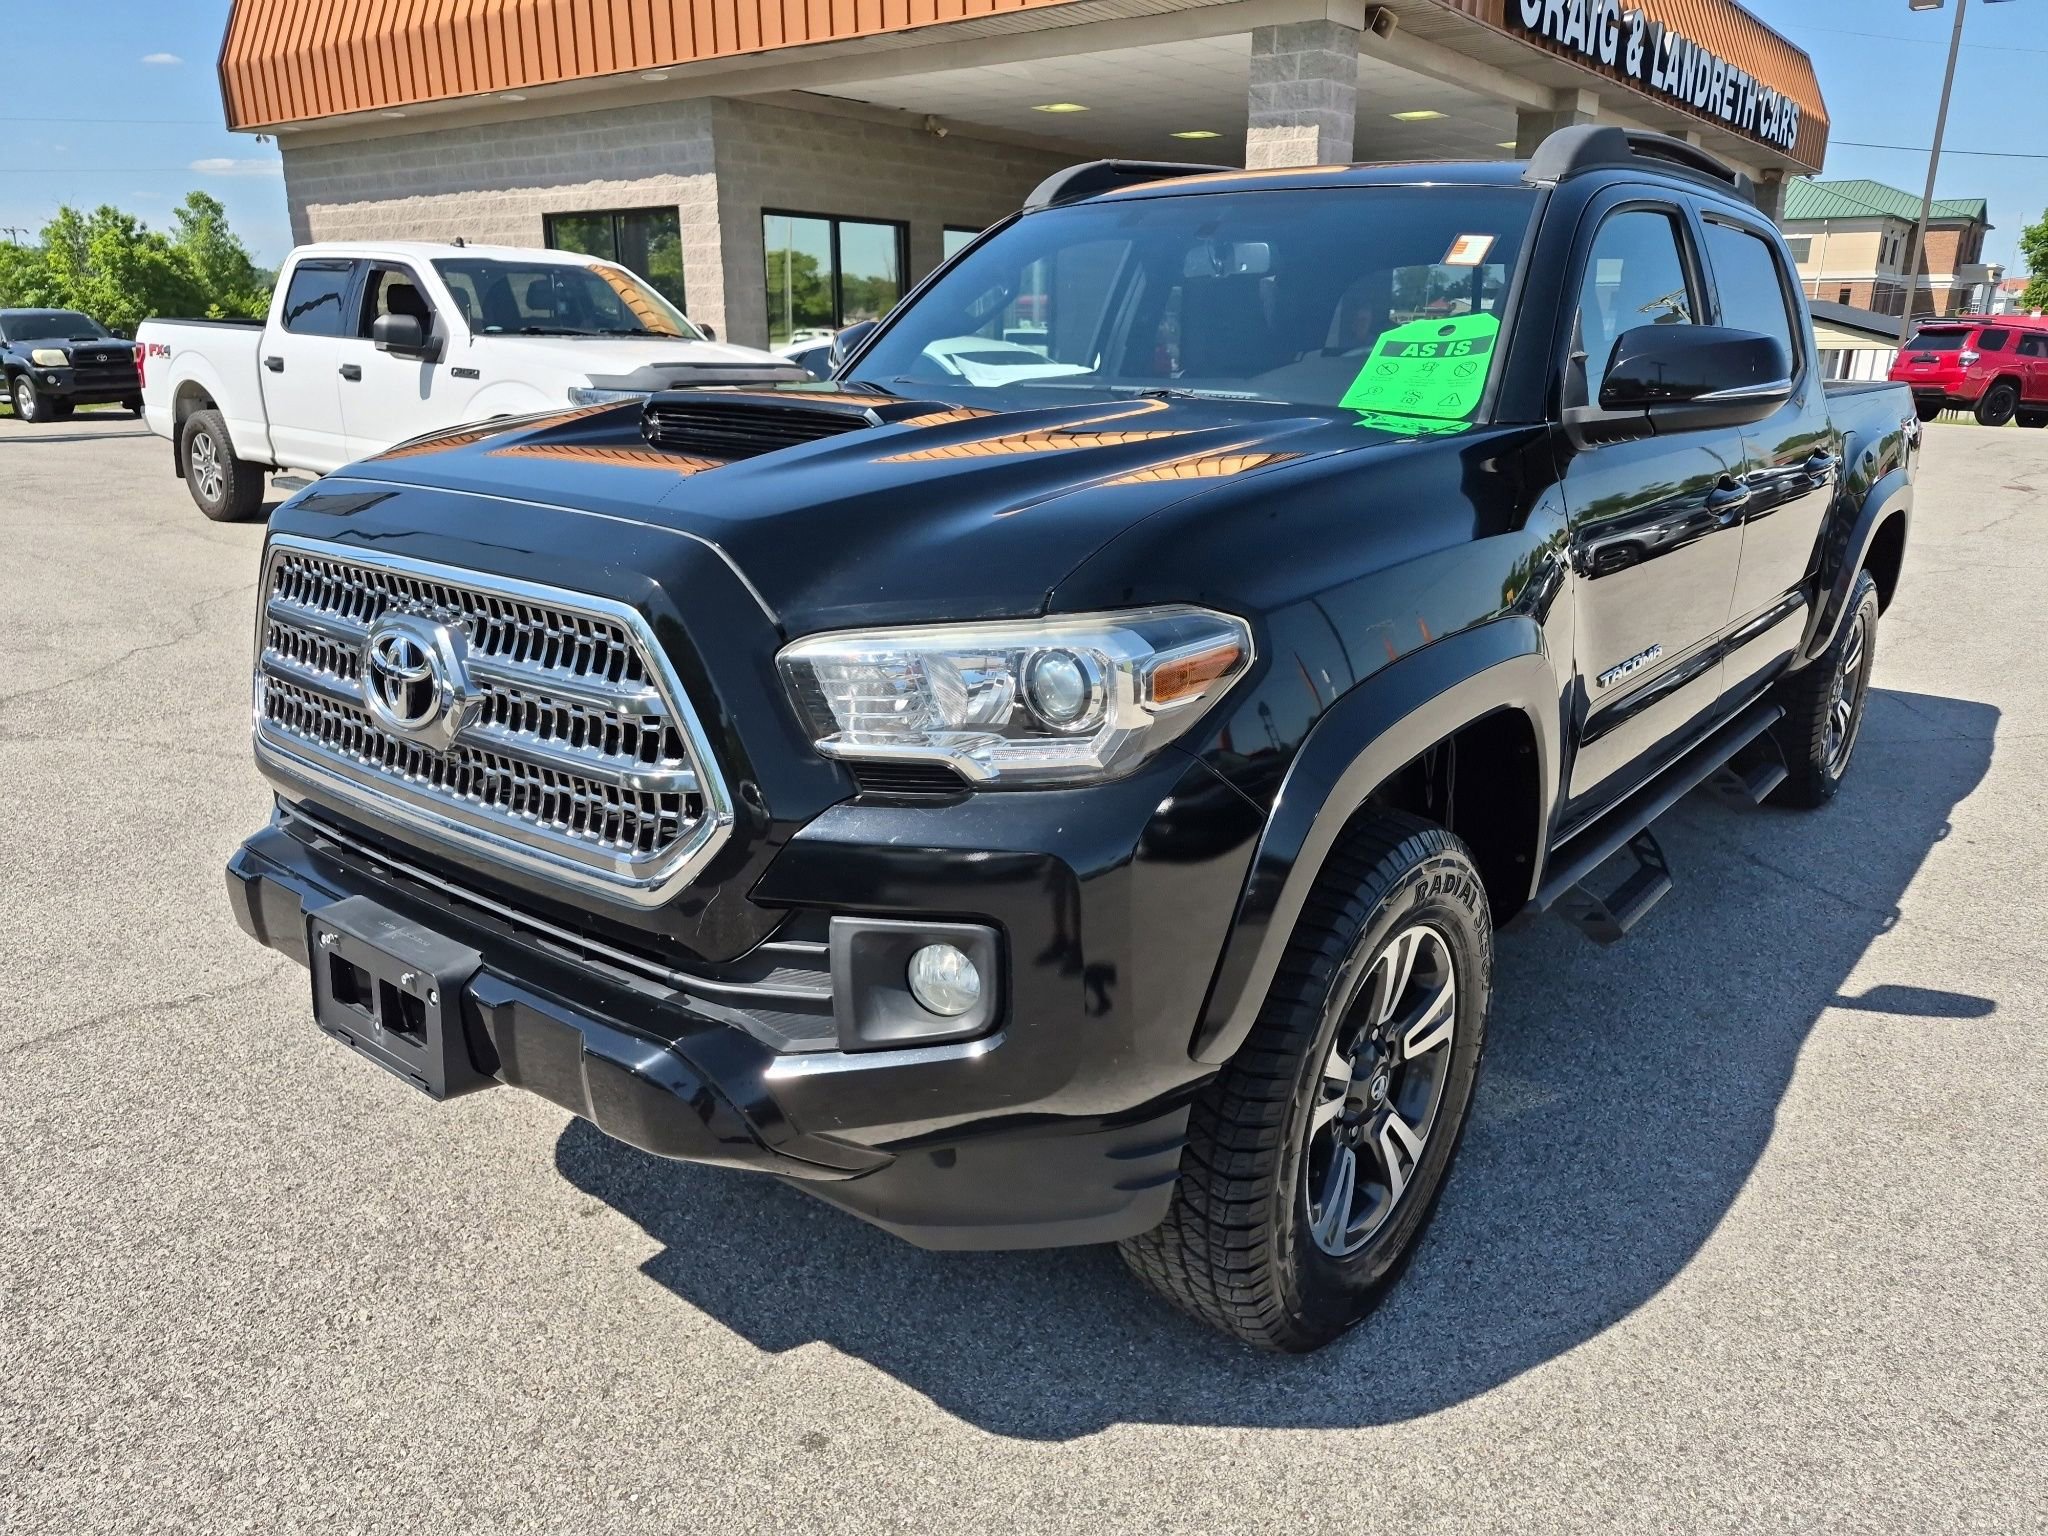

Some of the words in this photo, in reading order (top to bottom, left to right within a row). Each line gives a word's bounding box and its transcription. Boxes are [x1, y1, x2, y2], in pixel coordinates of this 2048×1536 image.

[1626, 9, 1645, 79] &
[1650, 22, 1759, 130] LANDRETH
[1760, 86, 1800, 150] CARS
[149, 344, 171, 357] FX4
[1400, 343, 1438, 357] AS
[1444, 340, 1473, 356] IS
[1597, 644, 1663, 688] TACOMA
[1412, 872, 1477, 916] RADIAL
